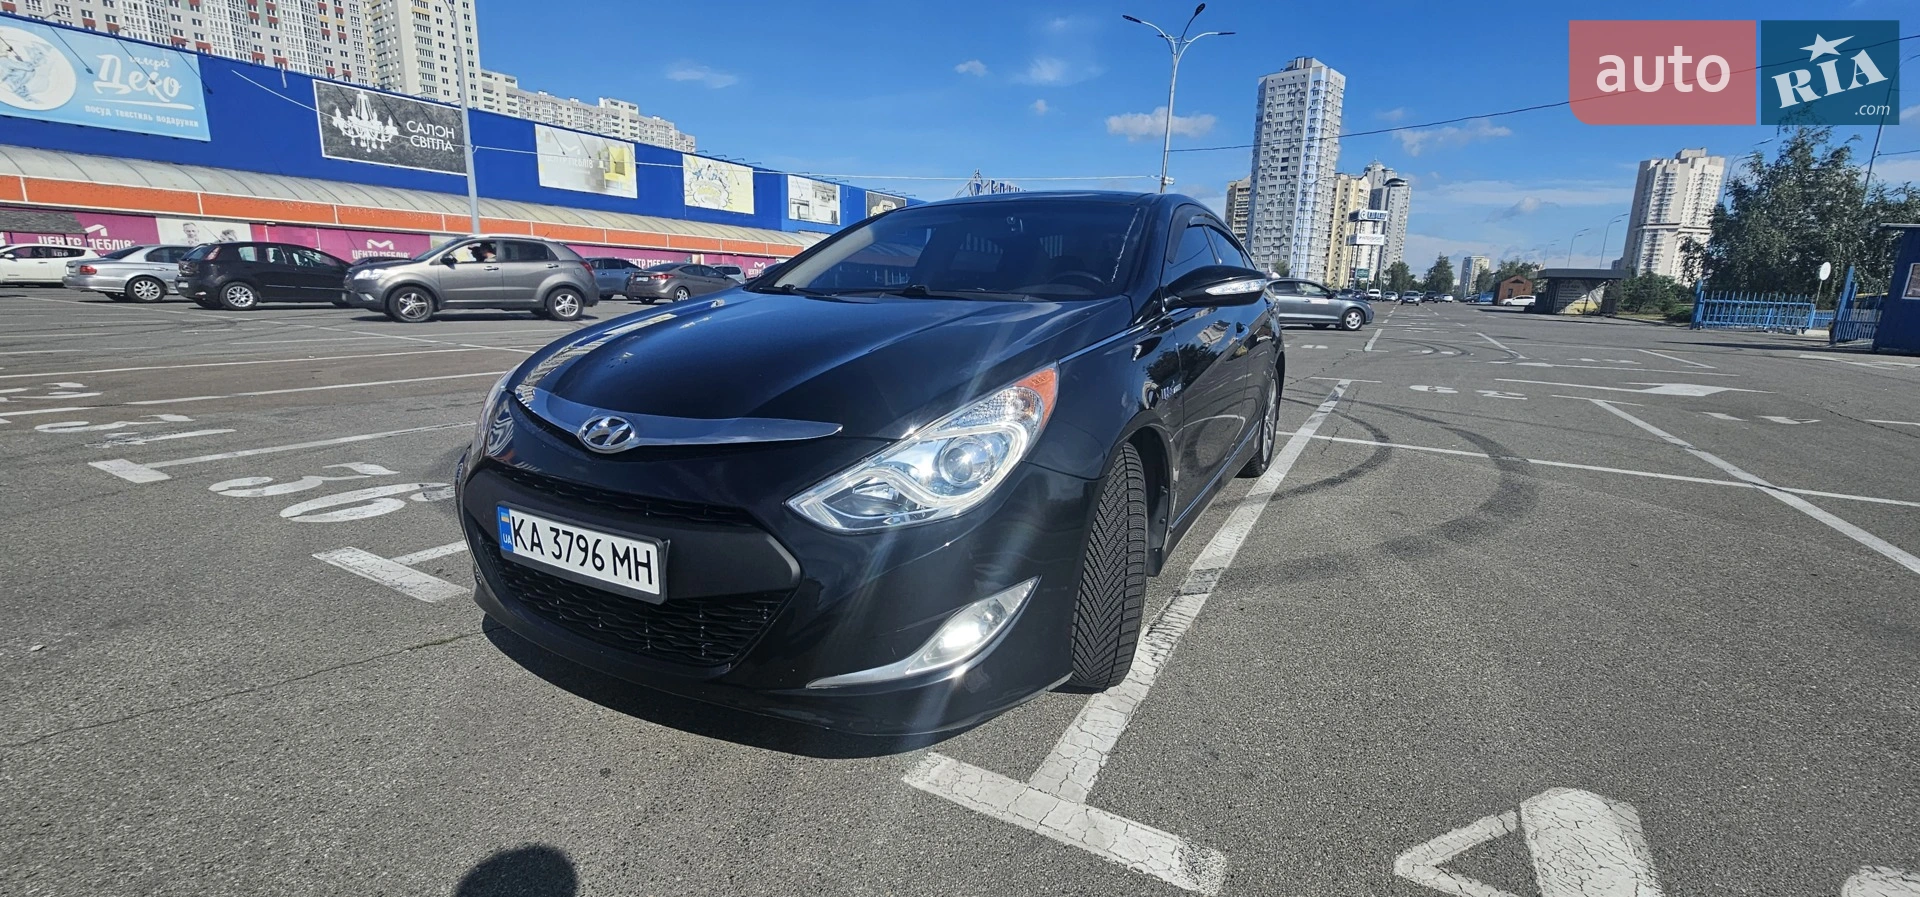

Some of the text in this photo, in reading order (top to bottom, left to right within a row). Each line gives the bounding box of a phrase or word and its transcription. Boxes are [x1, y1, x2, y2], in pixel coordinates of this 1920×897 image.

[93, 54, 182, 103] Деко
[85, 105, 199, 128] посуд текстиль подарунки
[406, 120, 455, 139] САЛОН
[410, 135, 455, 152] СВІТЛА
[502, 516, 653, 586] UA KA 3796 MH
